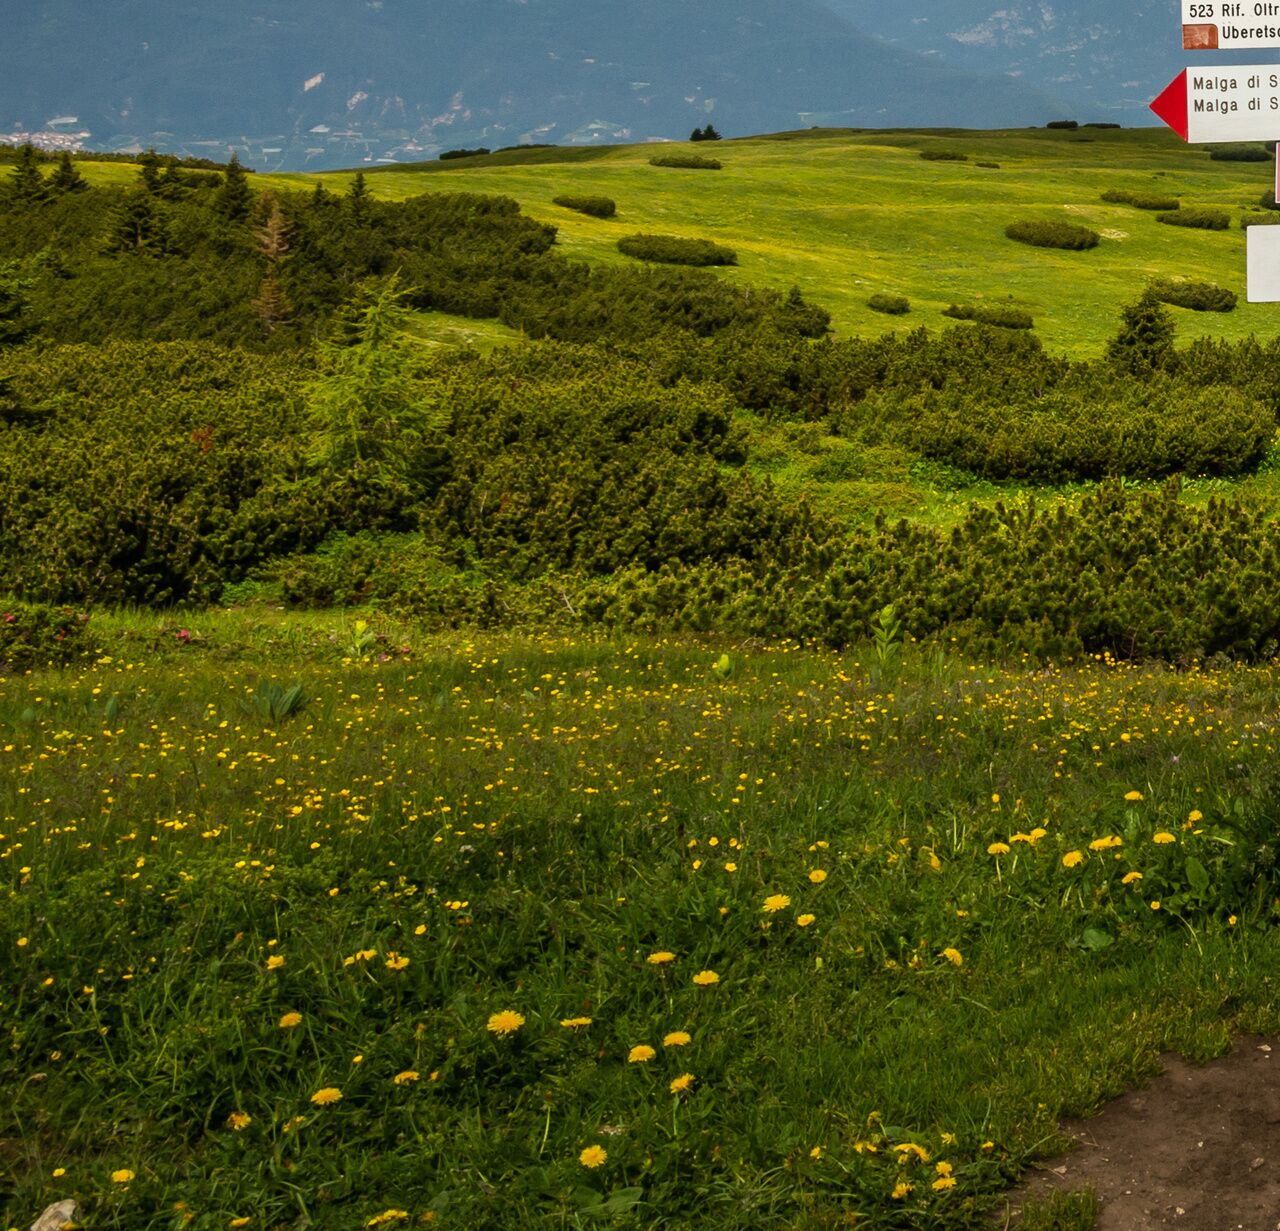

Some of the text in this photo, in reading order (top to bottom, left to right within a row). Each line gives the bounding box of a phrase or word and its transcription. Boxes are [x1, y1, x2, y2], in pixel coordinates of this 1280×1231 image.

[1189, 4, 1213, 17] 523
[1221, 3, 1244, 16] Rif.
[1193, 76, 1237, 92] Malga
[1247, 75, 1259, 88] di
[1194, 98, 1237, 114] Malga
[1247, 97, 1260, 110] di
